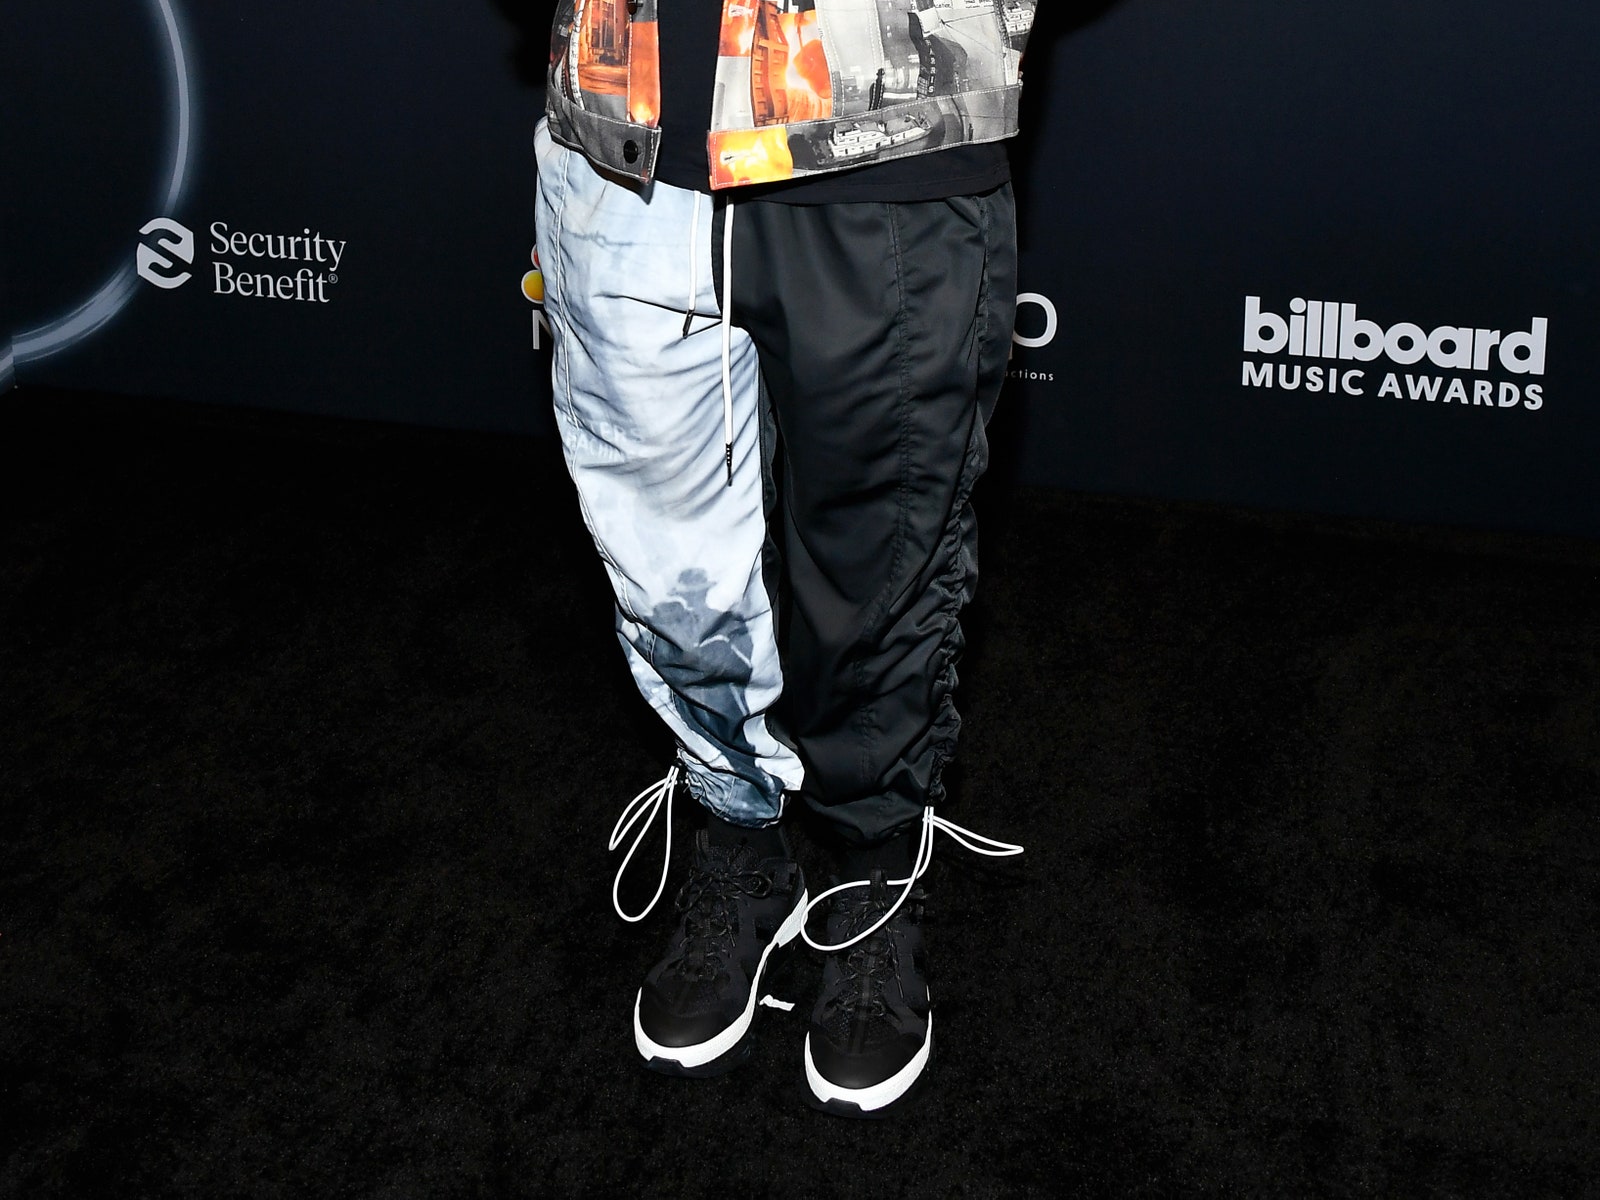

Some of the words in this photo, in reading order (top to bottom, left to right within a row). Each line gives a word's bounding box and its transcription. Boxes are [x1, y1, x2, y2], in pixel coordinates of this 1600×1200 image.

[210, 222, 346, 271] Security
[1244, 296, 1547, 375] billboard
[1242, 361, 1364, 395] MUSIC
[1378, 373, 1542, 410] AWARDS
